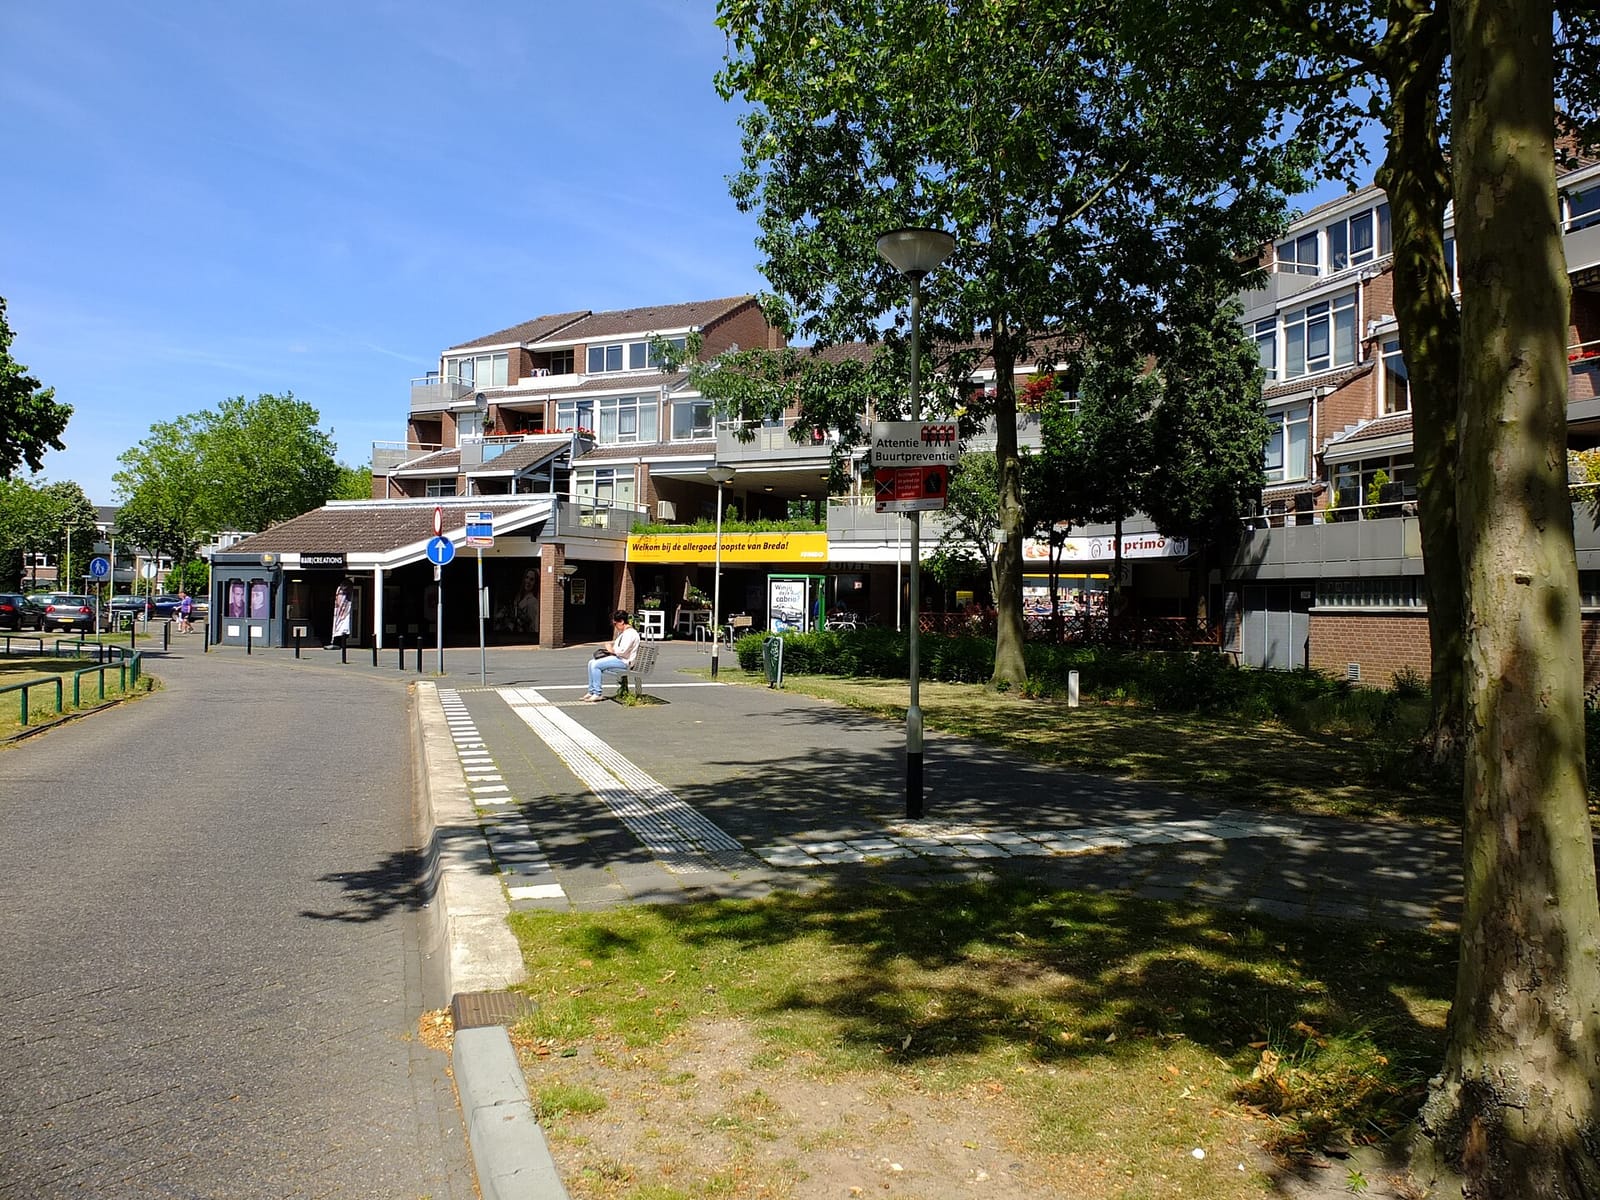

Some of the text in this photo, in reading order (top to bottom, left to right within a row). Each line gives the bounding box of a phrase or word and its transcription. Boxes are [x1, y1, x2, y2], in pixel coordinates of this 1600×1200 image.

[876, 438, 919, 448] Attentie
[875, 451, 955, 463] Buurtpreventie
[632, 543, 660, 551] Welkom
[661, 543, 671, 553] bij
[672, 543, 681, 551] de
[682, 542, 745, 553] allergoedoopste
[763, 542, 789, 550] Breda!
